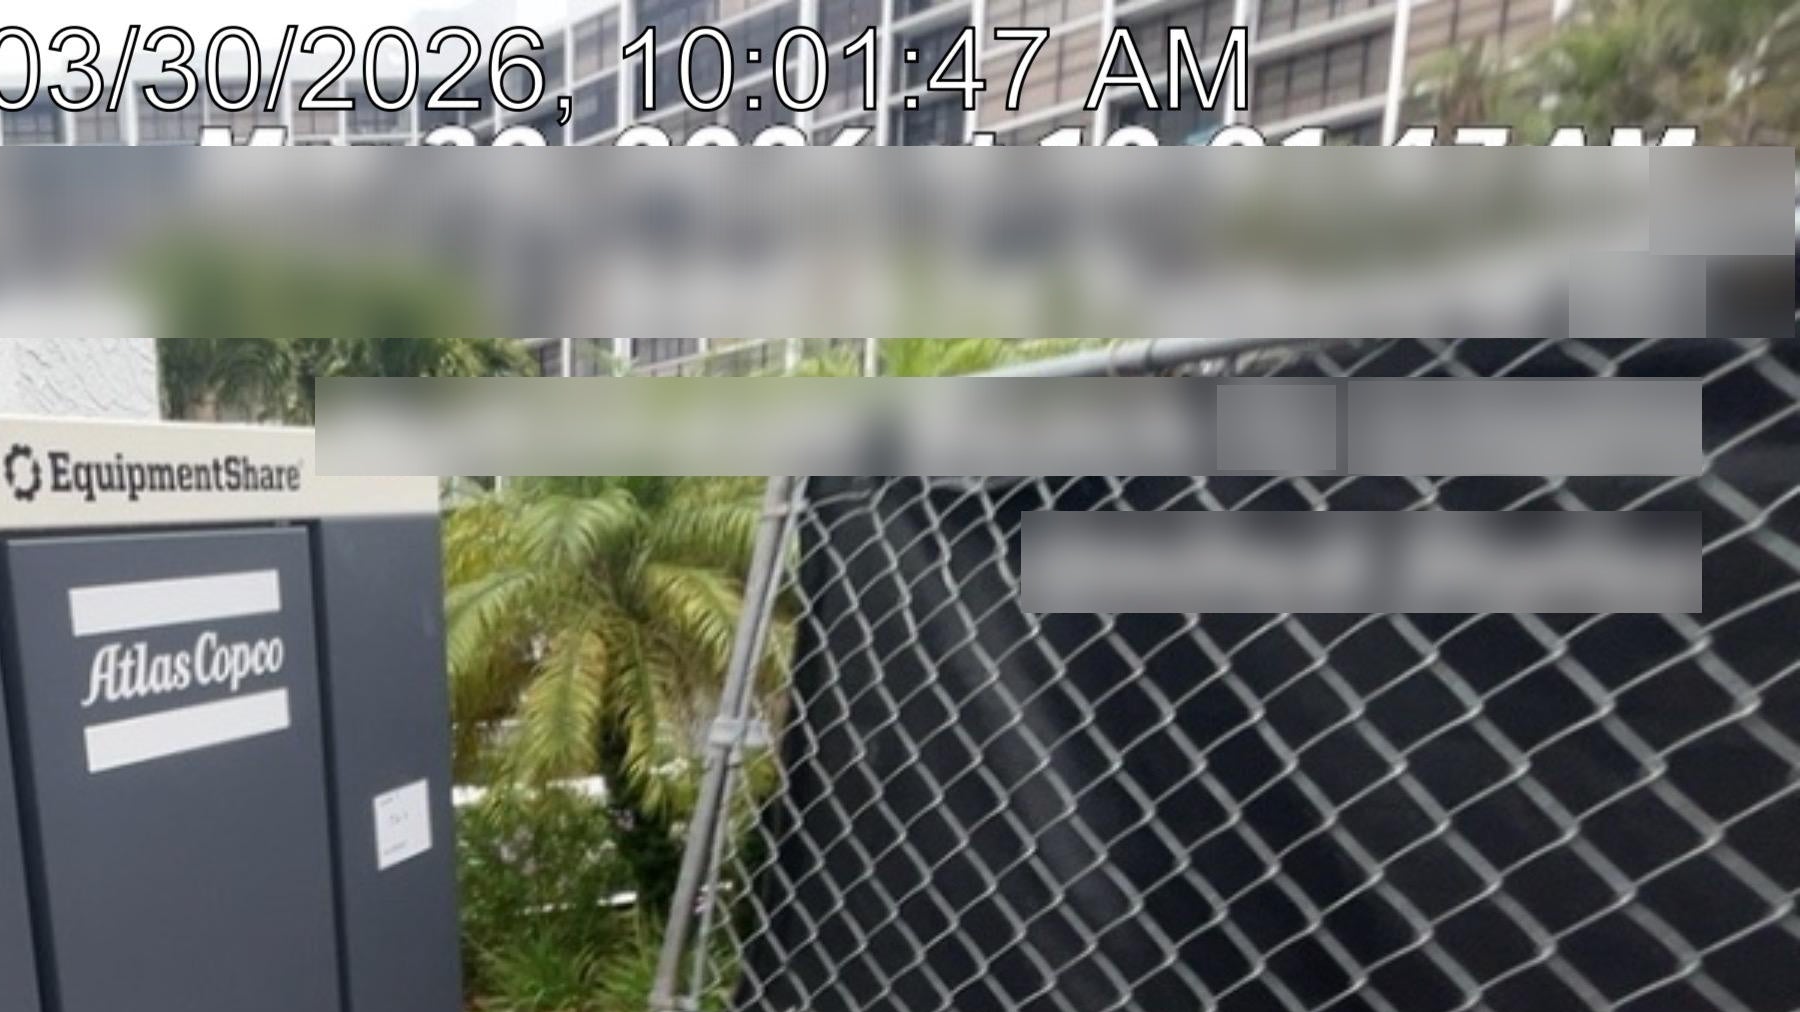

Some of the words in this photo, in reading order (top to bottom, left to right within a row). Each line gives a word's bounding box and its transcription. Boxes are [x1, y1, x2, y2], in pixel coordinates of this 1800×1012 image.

[48, 451, 300, 501] EquipmentShare
[80, 641, 192, 708] Atlas
[195, 630, 284, 691] Copco
